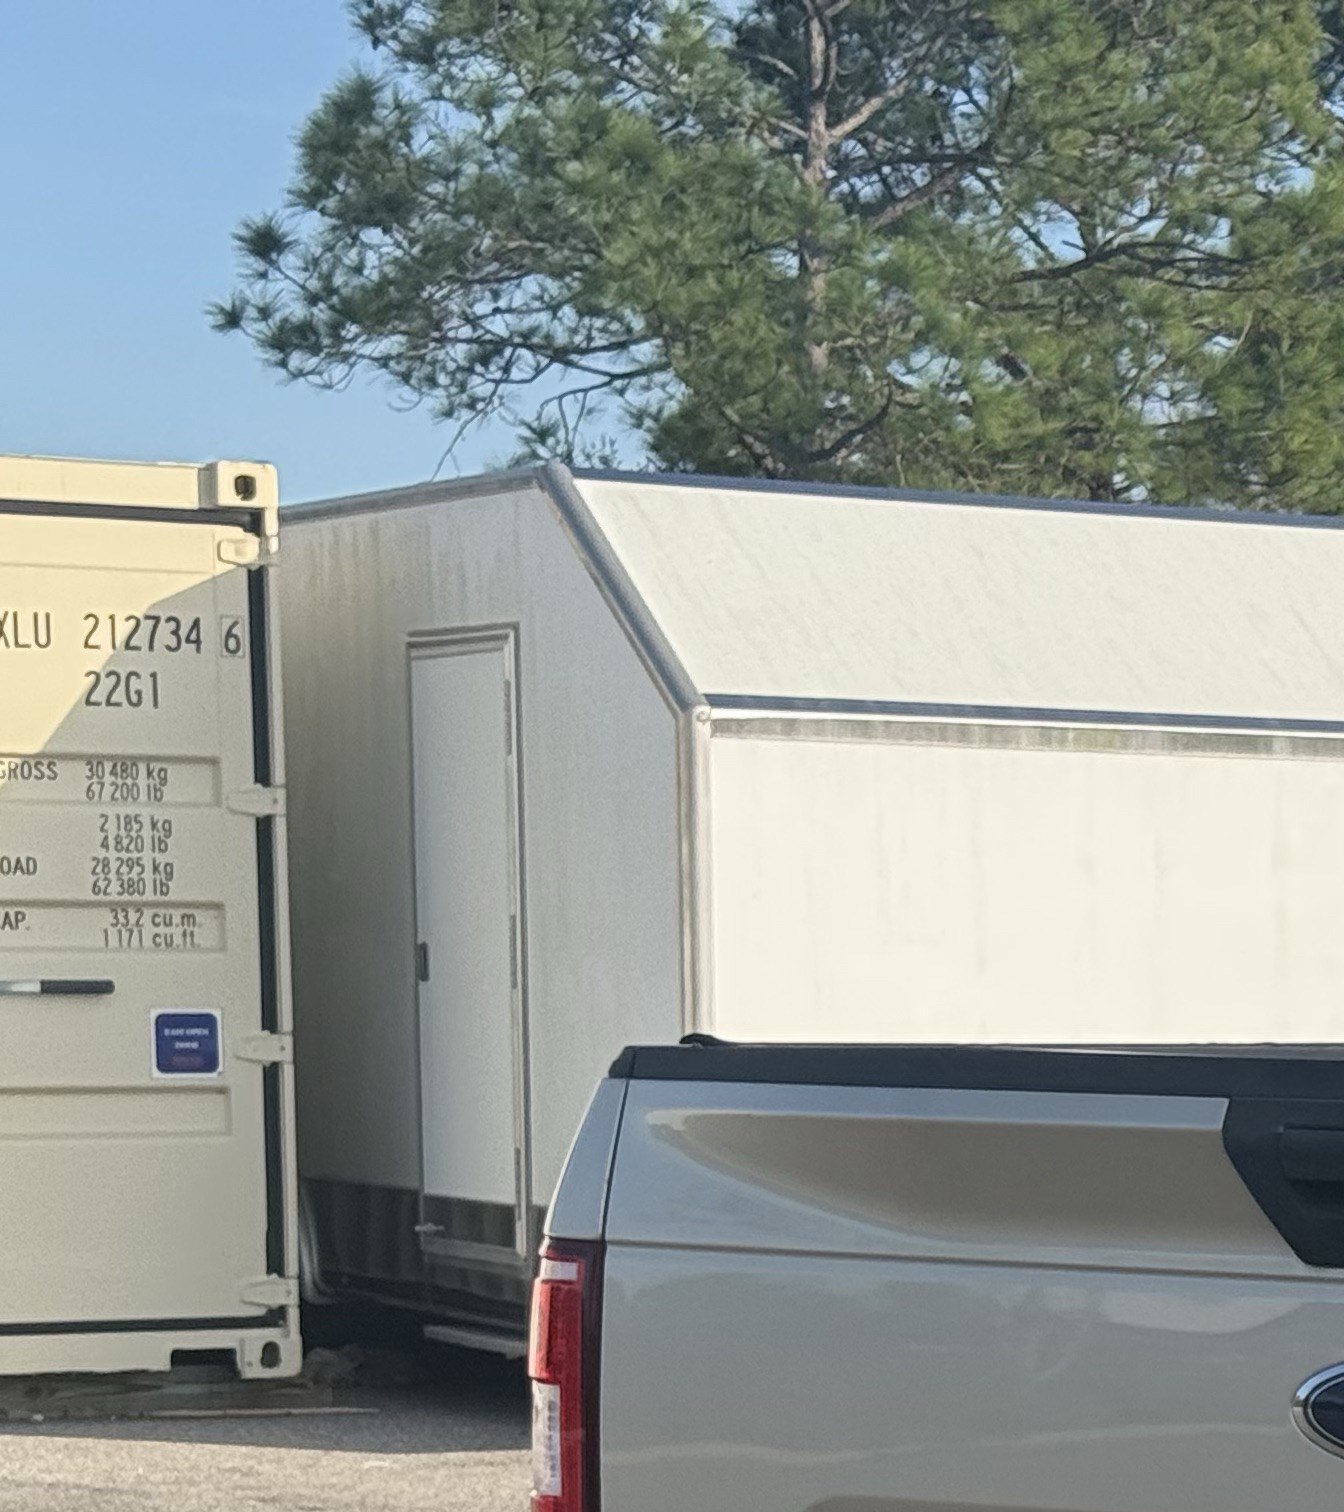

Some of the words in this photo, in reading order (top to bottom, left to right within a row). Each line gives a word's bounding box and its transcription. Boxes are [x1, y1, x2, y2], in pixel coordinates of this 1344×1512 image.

[83, 613, 203, 654] 212734
[223, 619, 242, 655] 6
[84, 670, 159, 709] 22G1
[146, 763, 168, 787] kg
[146, 783, 165, 802] lb
[150, 815, 172, 839] kg
[151, 834, 169, 853] lb
[0, 856, 38, 876] OAD
[152, 858, 174, 882] kg
[152, 879, 170, 897] lb
